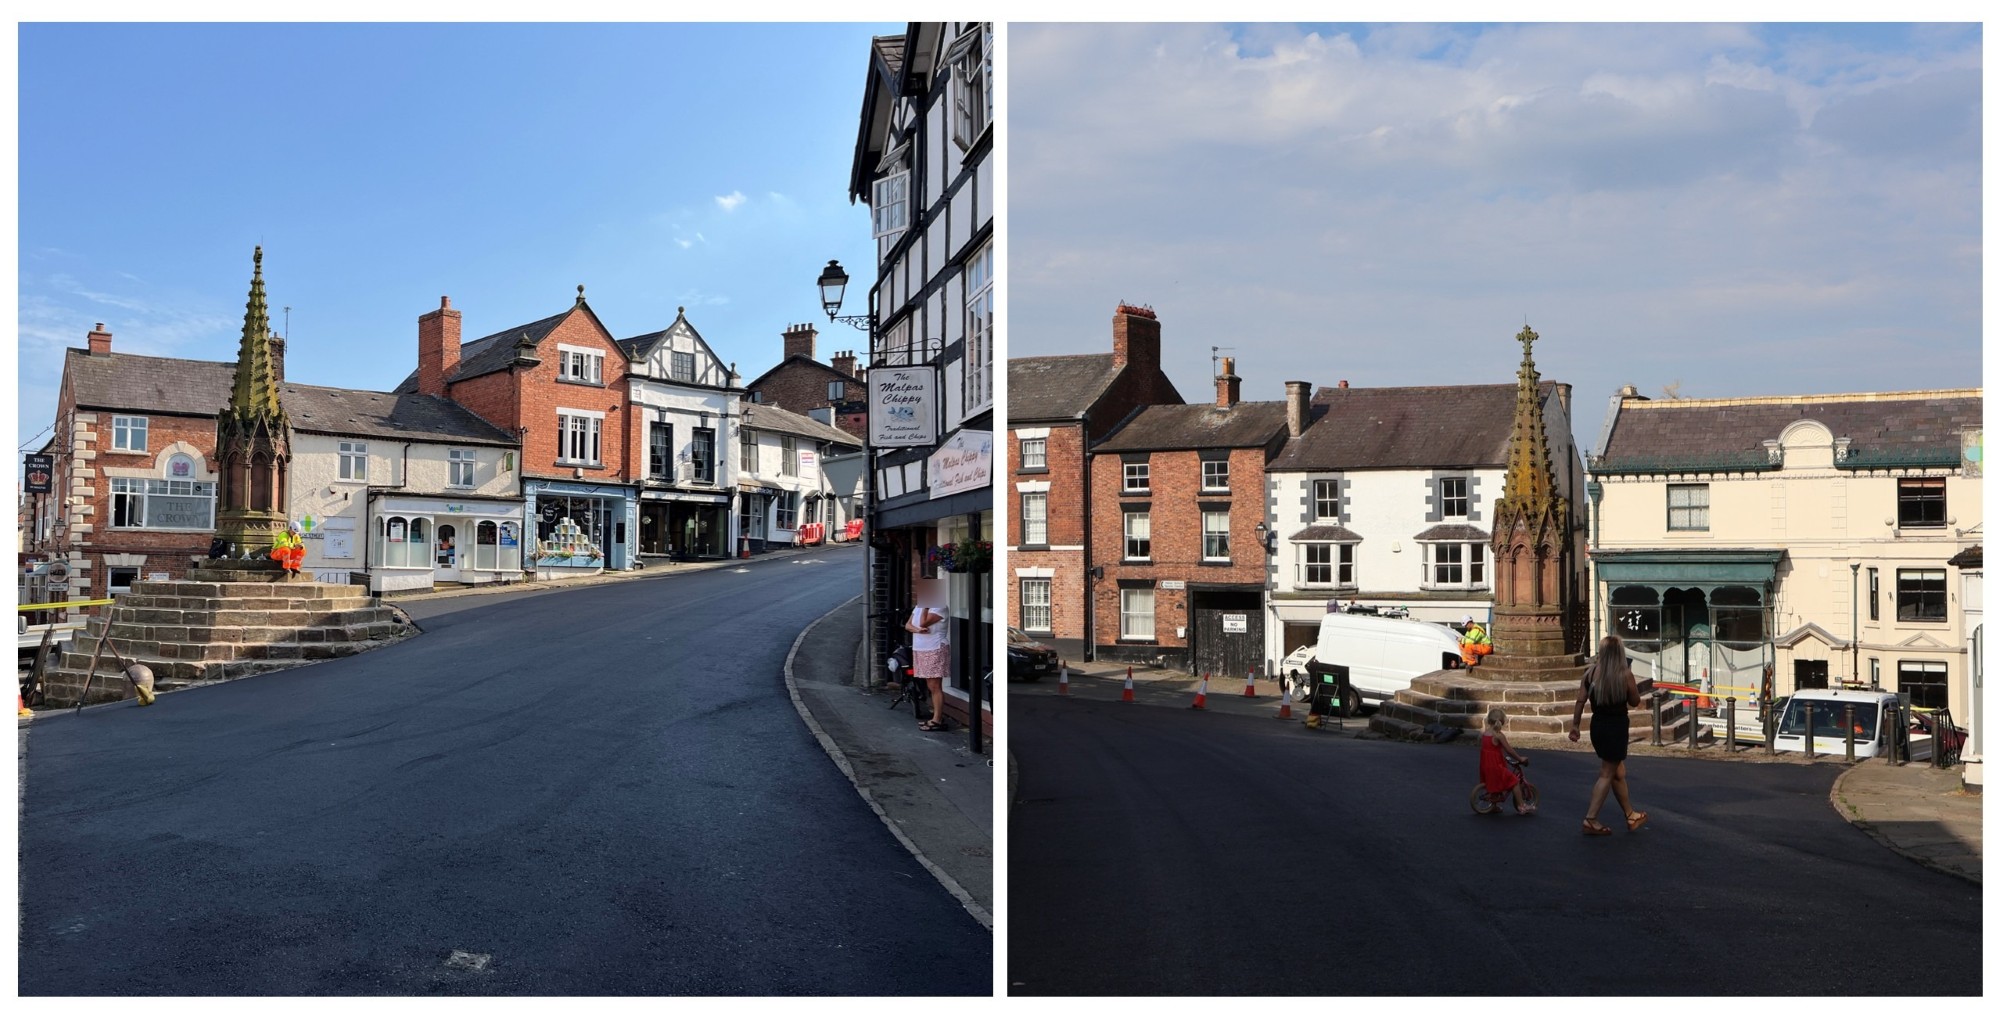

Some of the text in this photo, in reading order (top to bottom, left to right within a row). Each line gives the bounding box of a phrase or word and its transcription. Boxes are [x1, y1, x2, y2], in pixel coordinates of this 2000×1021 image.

[893, 373, 910, 381] The
[879, 382, 924, 393] Malpas
[882, 393, 922, 405] Chippy
[878, 433, 893, 441] Fish
[942, 449, 978, 470] Malpas Chippy
[954, 471, 964, 486] Fish
[964, 470, 973, 482] and
[973, 466, 986, 482] Chips
[166, 502, 192, 511] THE
[157, 513, 201, 523] CROWN
